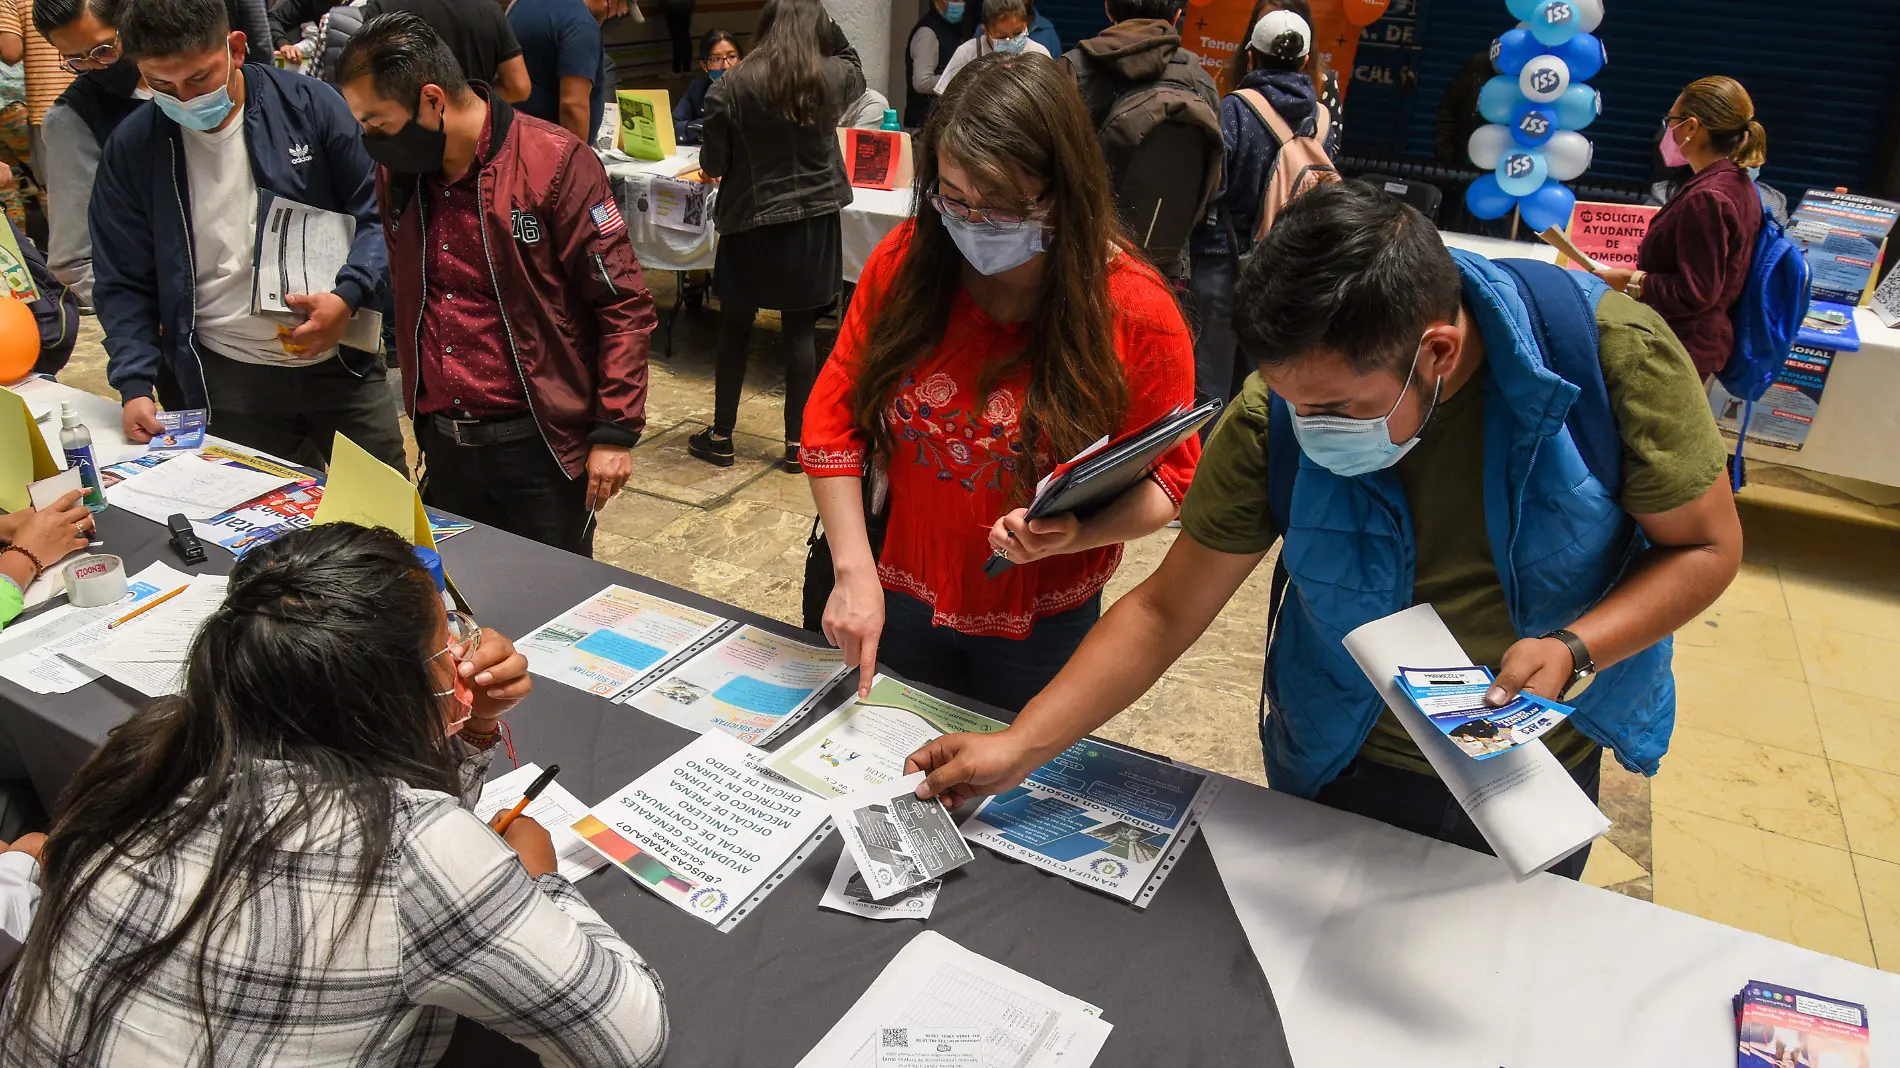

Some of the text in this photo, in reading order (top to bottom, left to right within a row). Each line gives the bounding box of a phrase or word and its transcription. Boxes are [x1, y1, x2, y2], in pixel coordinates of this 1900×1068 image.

[1547, 3, 1571, 24] iss
[1533, 70, 1557, 91] iss
[1519, 110, 1549, 134] iss
[291, 155, 313, 165] adidas
[1507, 155, 1531, 177] iss
[1808, 190, 1873, 204] SOLICITAMOS
[1831, 199, 1898, 214] PERSONAL
[1595, 212, 1645, 224] SOLICITA
[1583, 225, 1645, 237] AYUDANTE
[1606, 239, 1620, 253] DE
[75, 563, 107, 579] MENDOZA
[686, 760, 802, 818] ELECTRICO EN TURNO
[705, 757, 803, 803] OFICIAL DE TEJIDO
[669, 779, 773, 837] OFICIAL DE PRENSA
[673, 767, 792, 830] MECANICO DE TURNO
[1079, 800, 1108, 813] con
[634, 789, 761, 863] OFICIAL DE CONTINUAS
[678, 800, 739, 837] CANILLERO
[1110, 811, 1162, 834] Trabaja
[620, 796, 753, 875] AYUDANTES GENERALES
[616, 821, 722, 884] ¿BUSCAS TRABAJO?
[976, 831, 1119, 889] MANUFACTURAS QUALY
